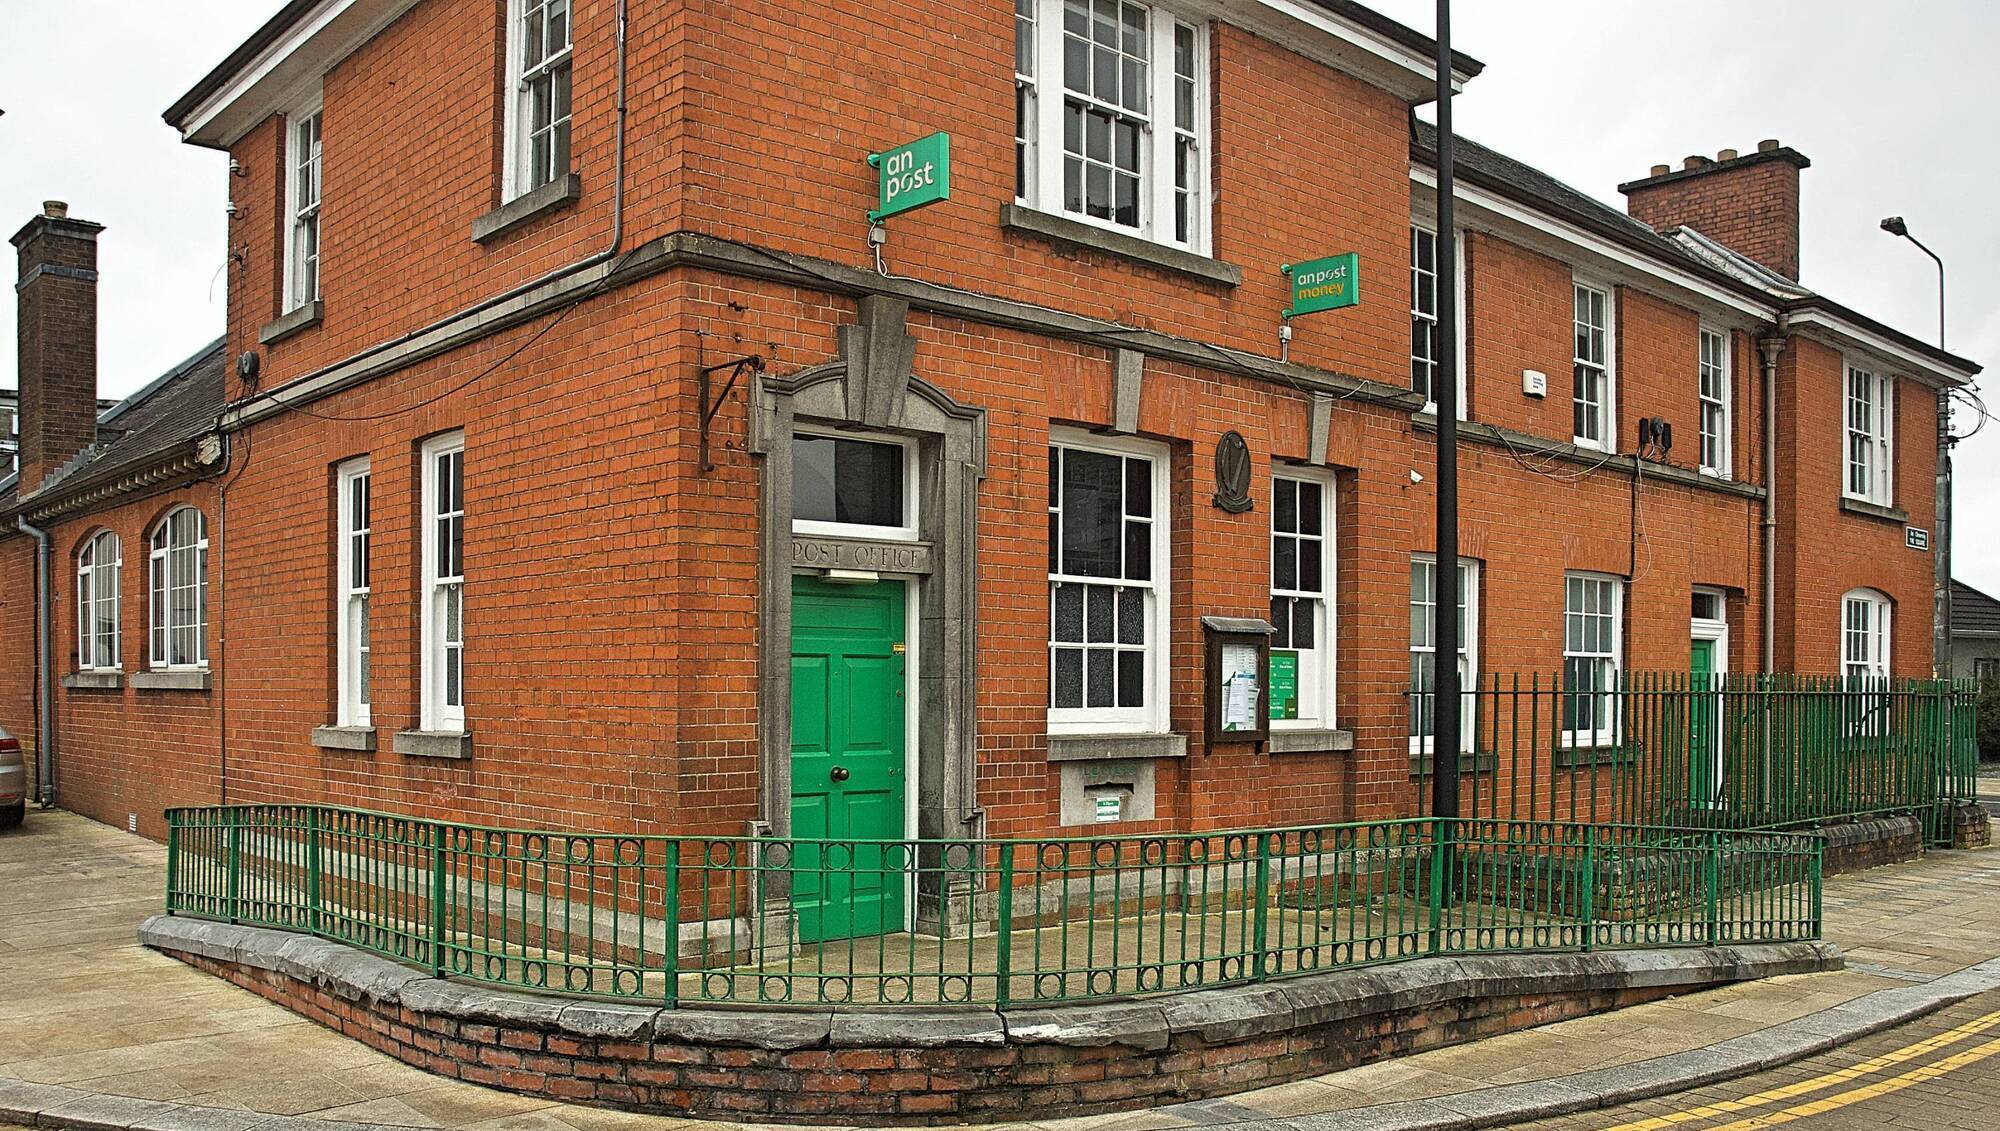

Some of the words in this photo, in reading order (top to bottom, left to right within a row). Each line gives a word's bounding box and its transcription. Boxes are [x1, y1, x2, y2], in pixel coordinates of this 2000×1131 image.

[887, 150, 913, 176] an
[886, 161, 934, 203] post
[1298, 282, 1344, 299] money
[792, 542, 843, 564] POST
[854, 546, 921, 569] OFFICE
